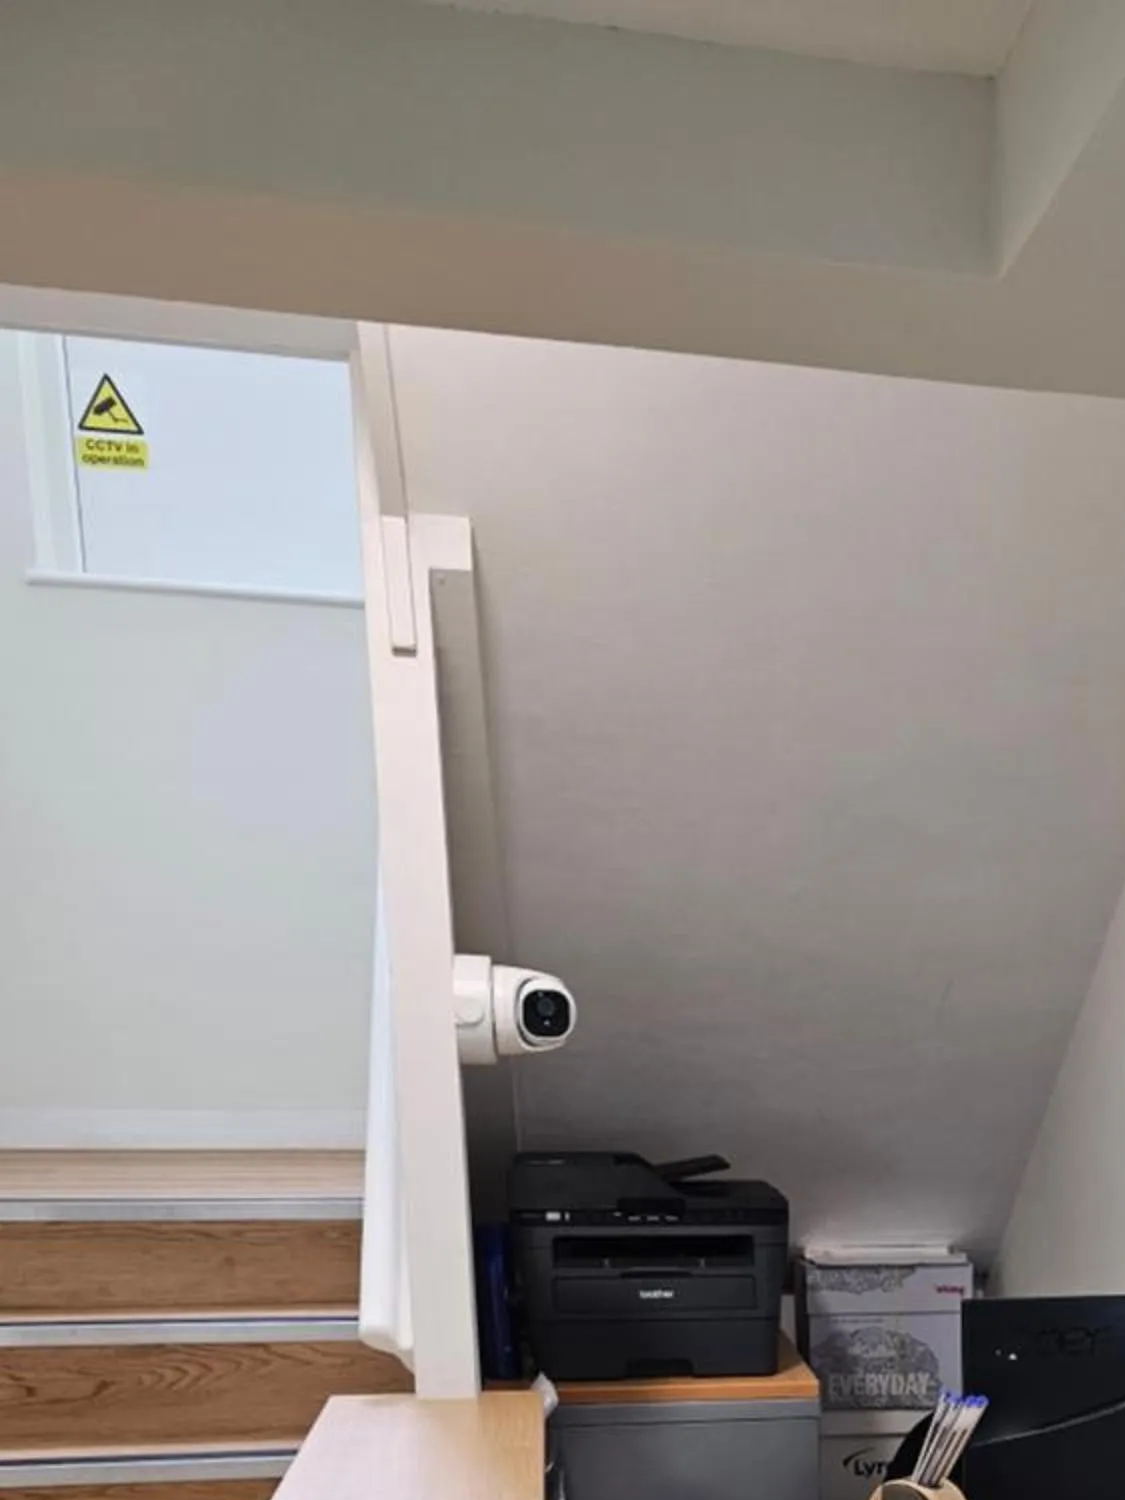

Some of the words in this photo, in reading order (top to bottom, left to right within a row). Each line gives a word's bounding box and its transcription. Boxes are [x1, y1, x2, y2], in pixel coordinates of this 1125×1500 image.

[85, 438, 123, 452] CCTV
[81, 453, 145, 467] operation
[828, 1372, 931, 1397] EVERYDAY
[854, 1460, 886, 1480] Lyr
